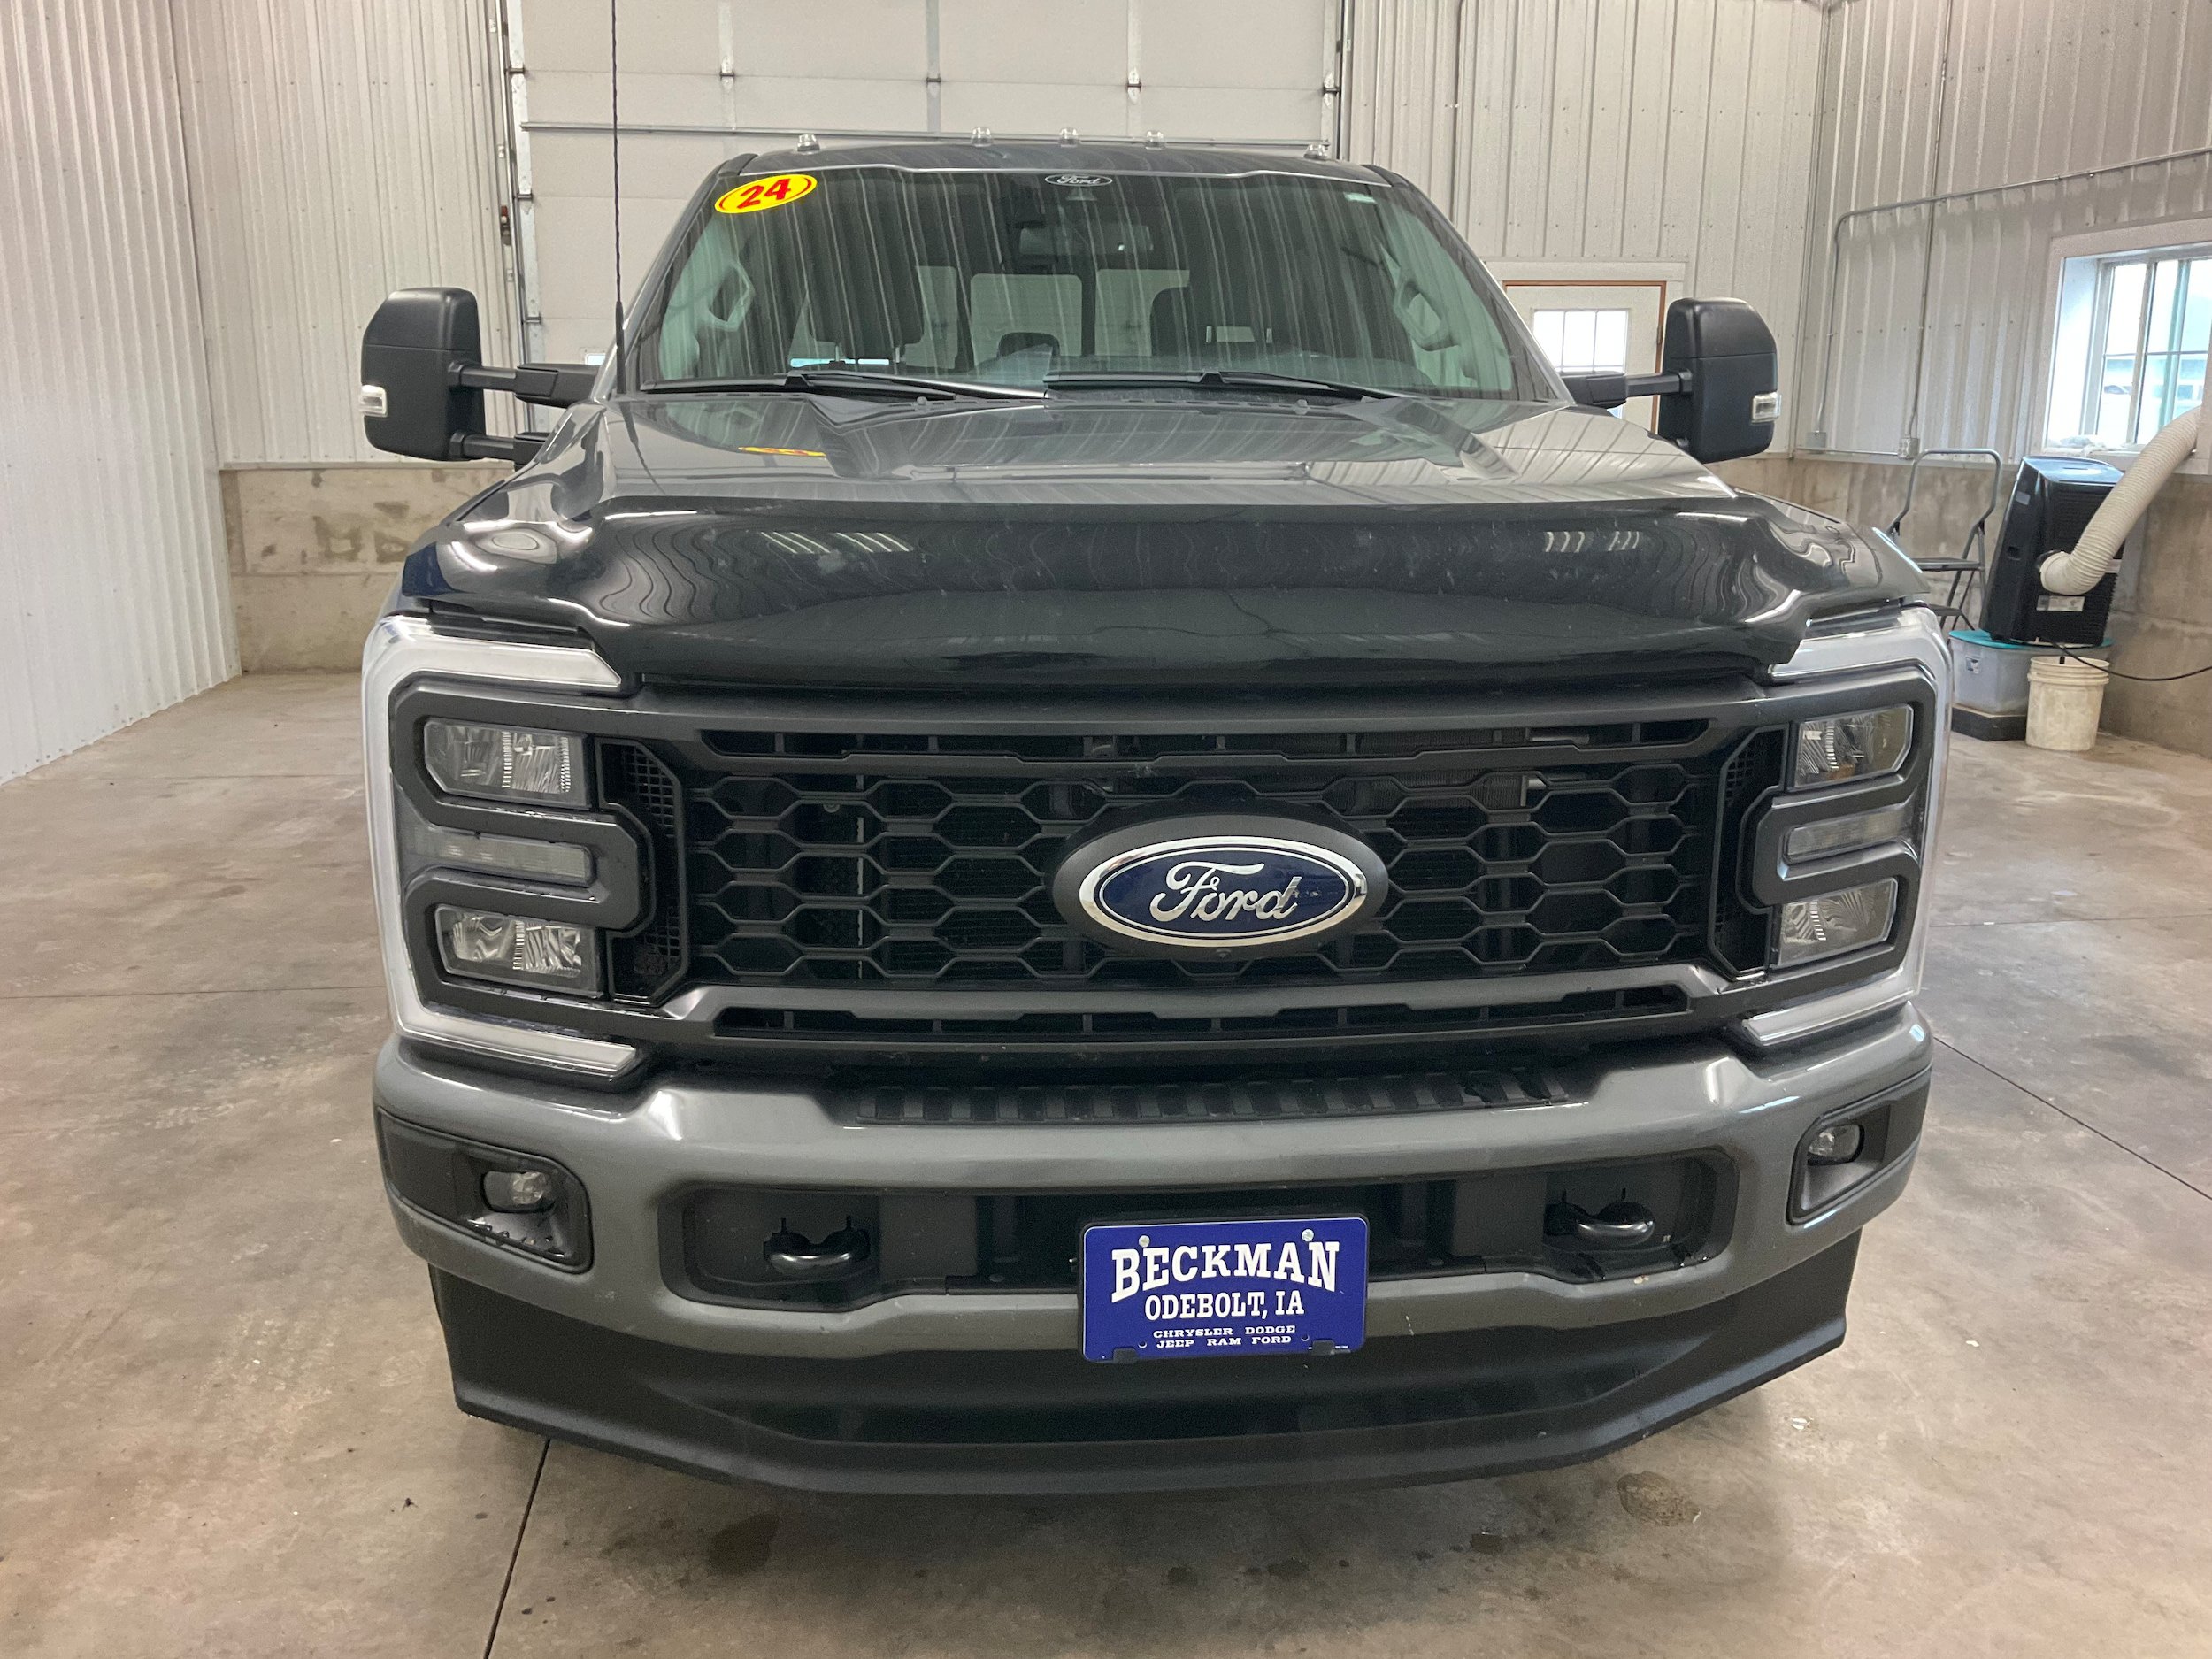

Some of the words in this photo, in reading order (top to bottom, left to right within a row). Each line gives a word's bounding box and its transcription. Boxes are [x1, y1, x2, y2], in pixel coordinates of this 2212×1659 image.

[737, 179, 791, 209] 24
[1056, 175, 1101, 184] Ford
[1150, 861, 1302, 922] Ford
[1111, 1241, 1340, 1303] BECKMAN
[1144, 1292, 1269, 1321] ODEBOLT,
[1275, 1290, 1305, 1316] IA
[1153, 1328, 1233, 1339] CHRYSLER
[1245, 1325, 1296, 1336] DODGE
[1156, 1339, 1194, 1348] JEEP
[1206, 1337, 1242, 1347] RAM
[1251, 1335, 1292, 1346] FORD
